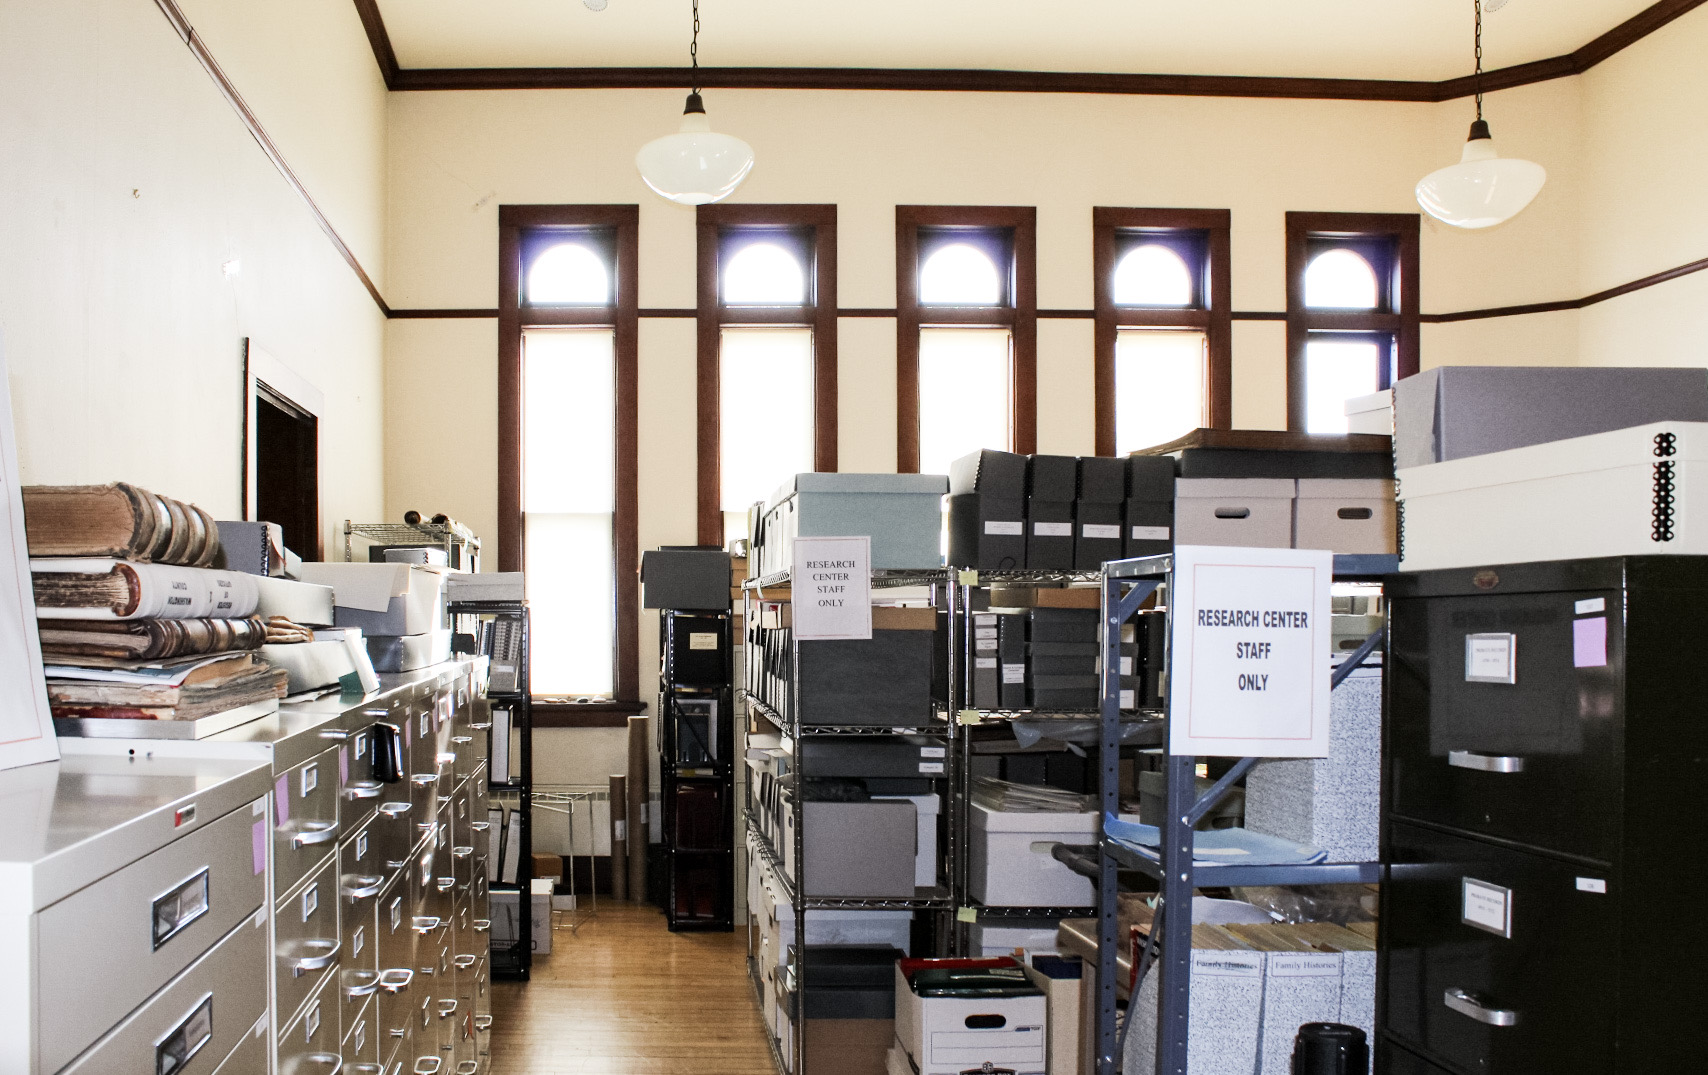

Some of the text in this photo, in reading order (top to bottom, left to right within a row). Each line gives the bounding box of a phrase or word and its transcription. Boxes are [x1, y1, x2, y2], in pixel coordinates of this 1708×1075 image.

[806, 560, 855, 569] RESEARCH
[812, 573, 849, 581] CENTER
[817, 586, 845, 594] STAFF
[818, 599, 844, 607] ONLY
[1198, 609, 1308, 628] RESEARCH CENTER
[1236, 641, 1271, 659] STAFF
[1238, 673, 1268, 691] ONLY
[1196, 960, 1221, 969] Family
[1275, 961, 1336, 969] Family Histories
